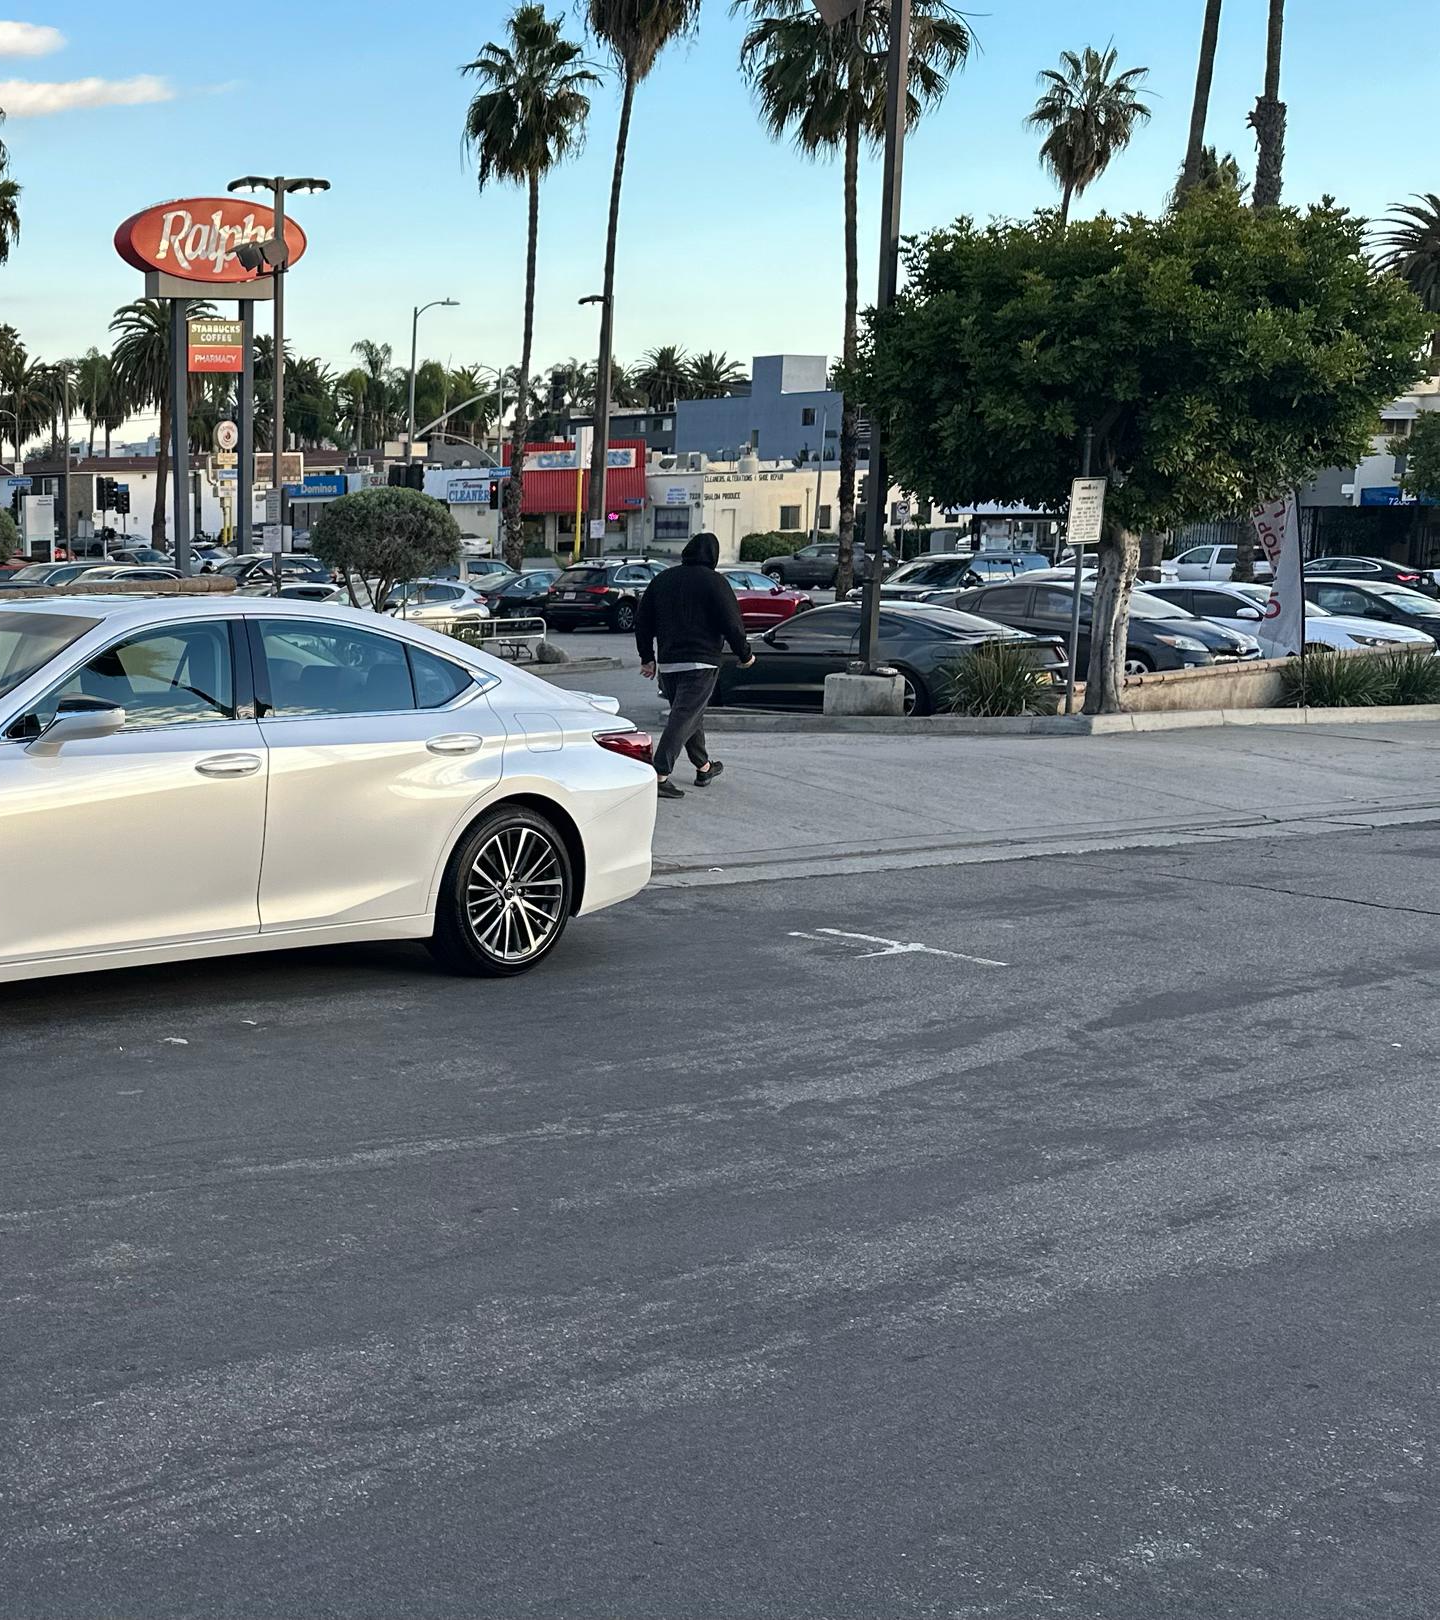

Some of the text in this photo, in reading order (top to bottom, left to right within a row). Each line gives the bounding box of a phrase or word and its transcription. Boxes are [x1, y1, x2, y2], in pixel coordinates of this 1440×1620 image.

[191, 324, 241, 333] STARBUCKS
[200, 334, 232, 342] COFFEE
[194, 354, 237, 363] PHARMACY
[721, 492, 741, 500] PRODUCE
